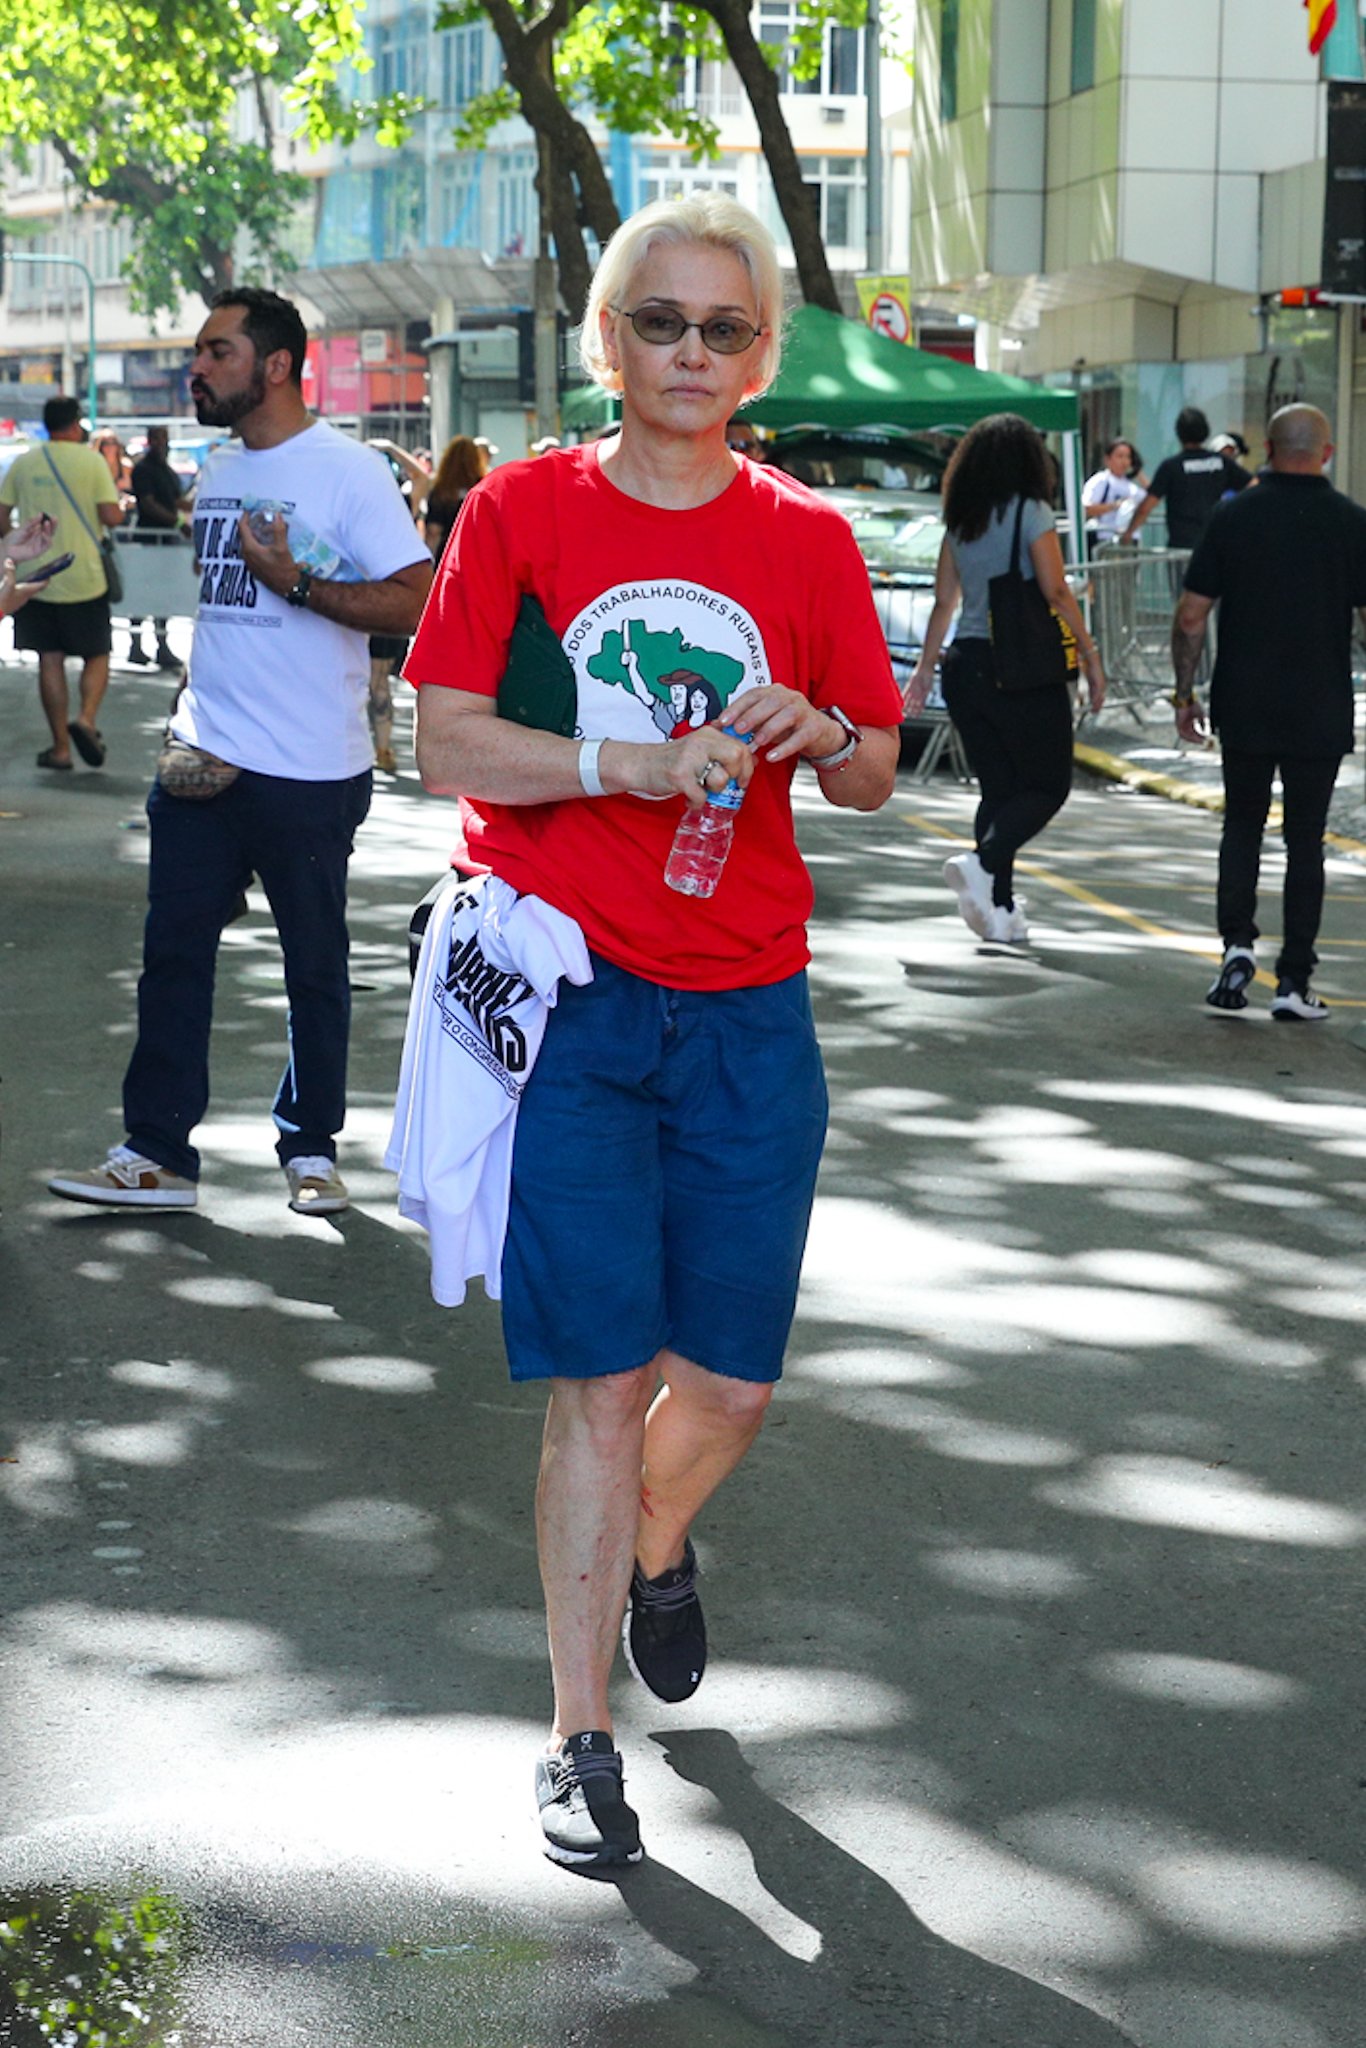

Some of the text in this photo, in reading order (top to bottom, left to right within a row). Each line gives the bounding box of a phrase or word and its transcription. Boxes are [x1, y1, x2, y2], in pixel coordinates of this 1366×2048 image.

[568, 586, 762, 670] DOS TRABALHADORES RURAIS
[459, 1032, 508, 1082] CONGRESSO
